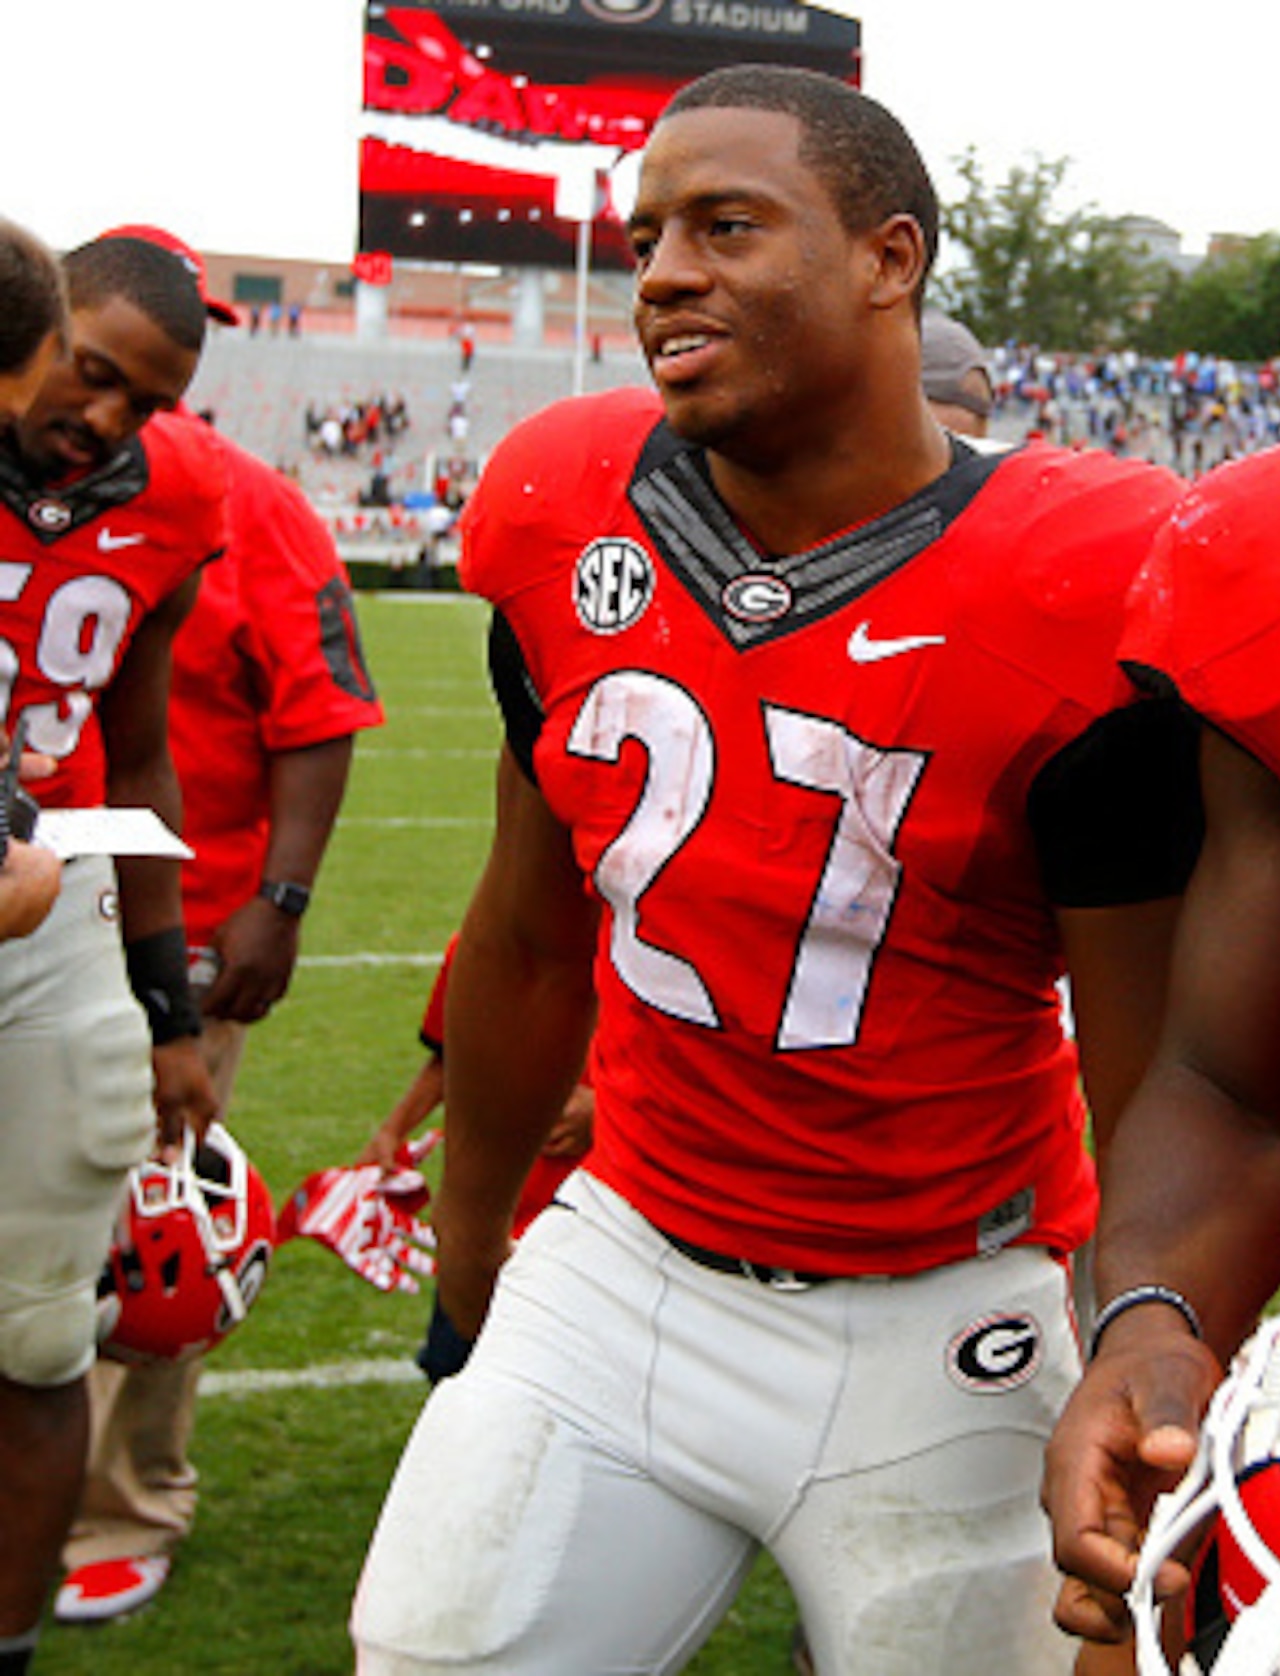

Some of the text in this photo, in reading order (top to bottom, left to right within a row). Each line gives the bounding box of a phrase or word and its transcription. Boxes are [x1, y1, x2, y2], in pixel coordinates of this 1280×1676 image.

[670, 1, 808, 32] STADIUM
[576, 544, 647, 627] SEC
[727, 580, 790, 617] G
[565, 667, 934, 1052] 27
[956, 1318, 1036, 1379] G
